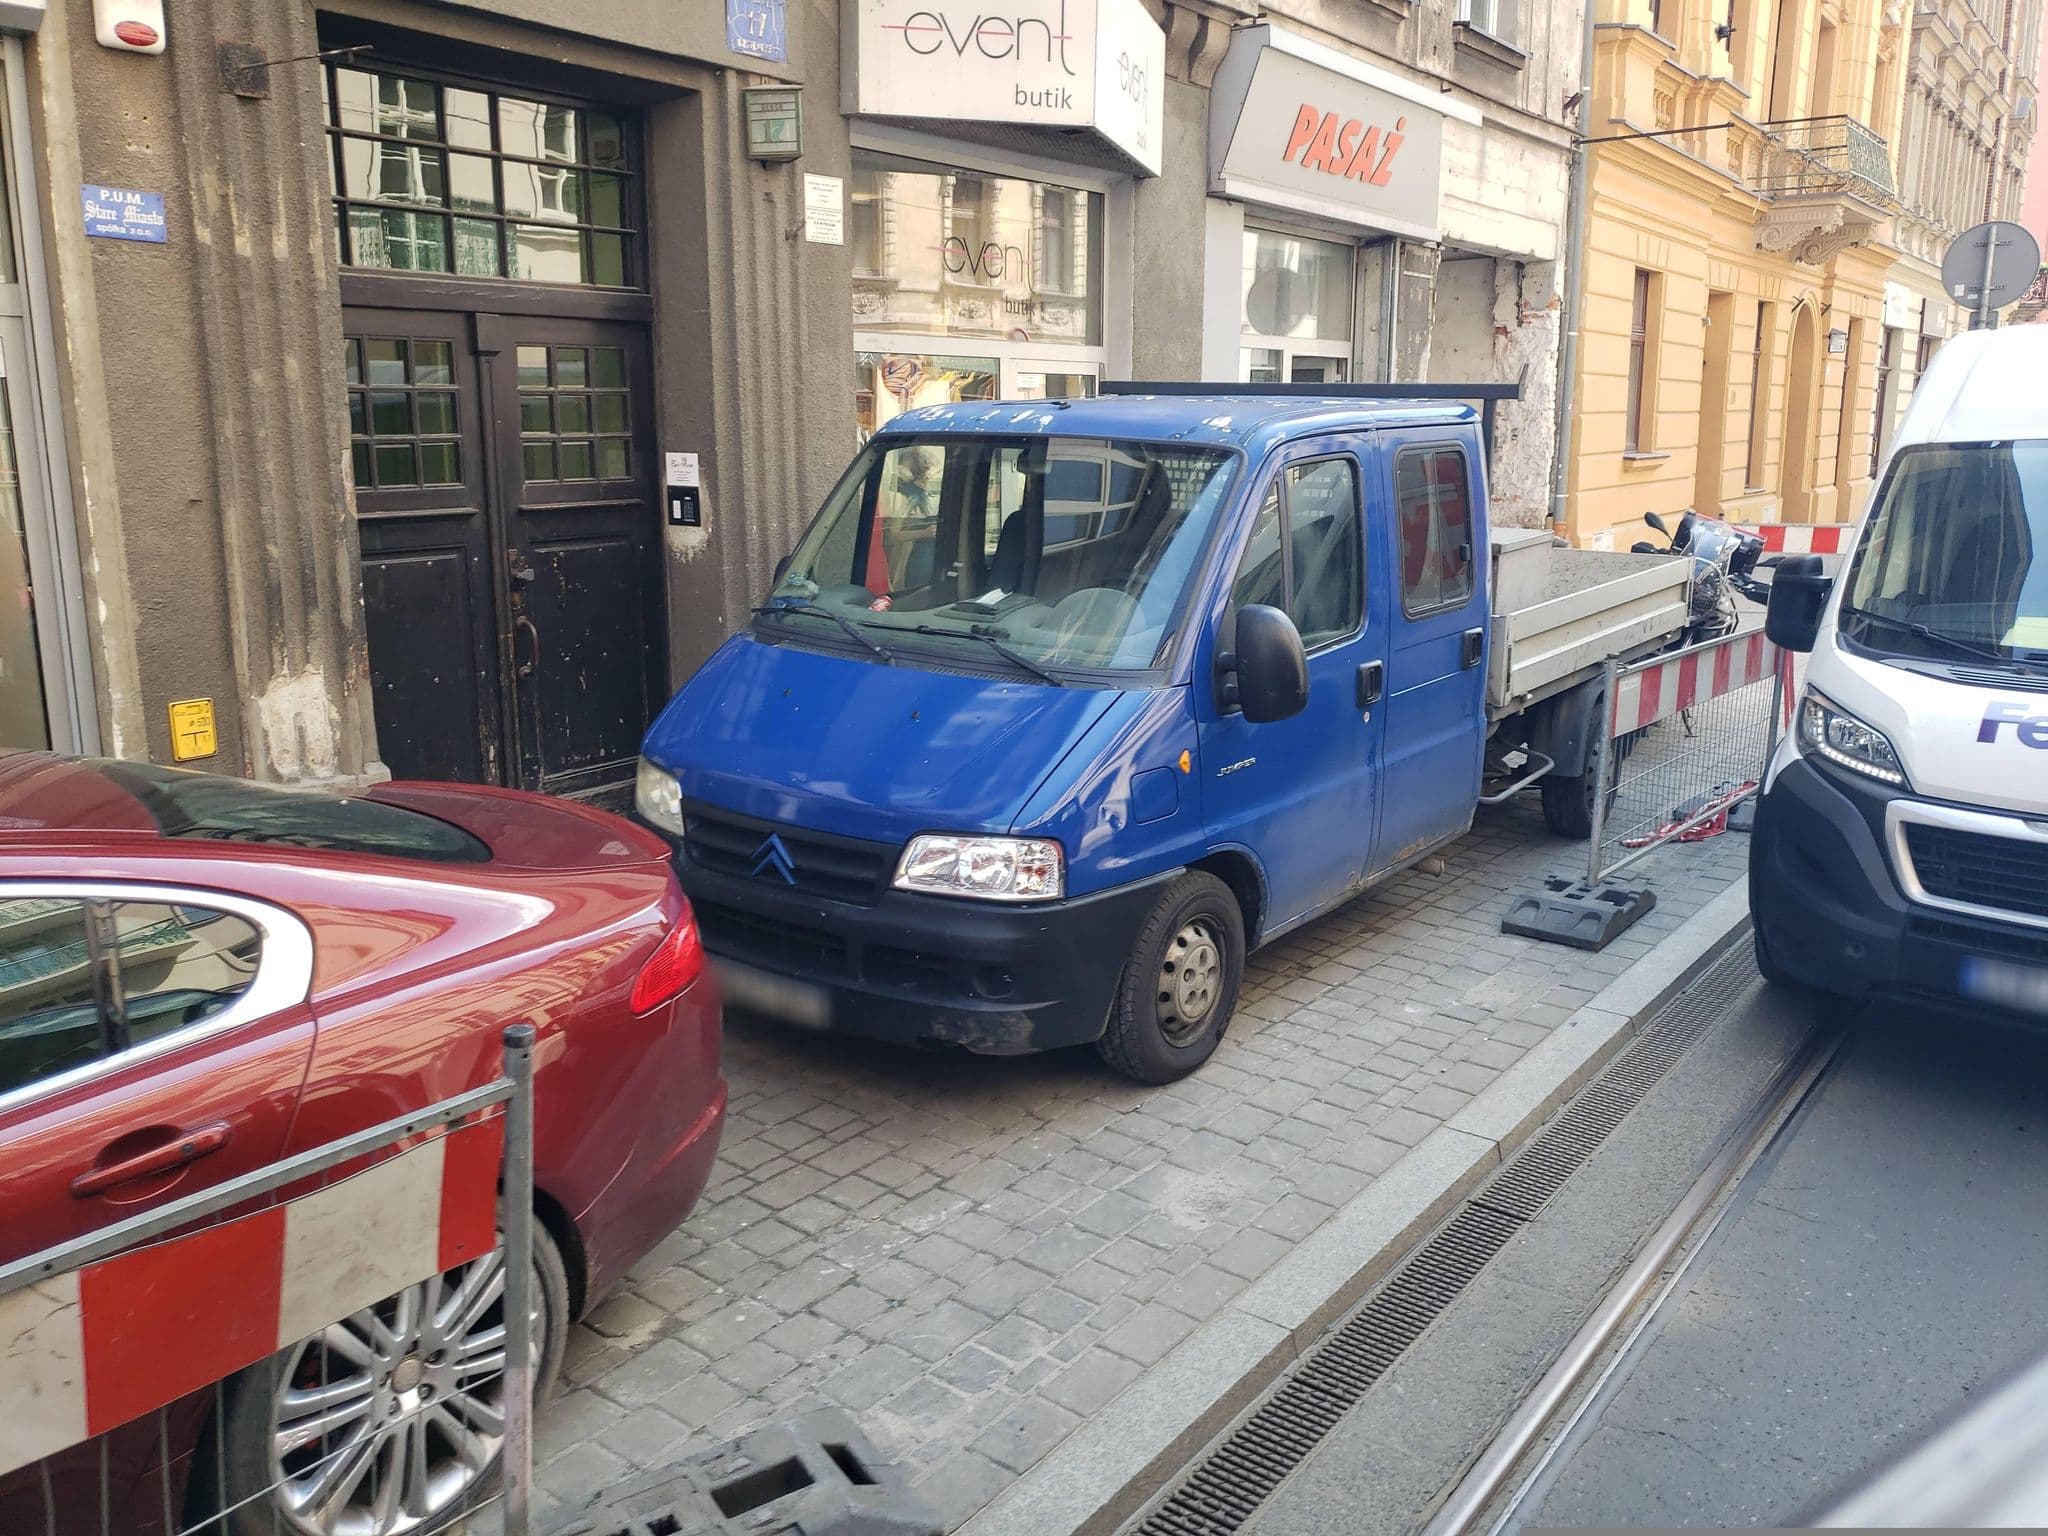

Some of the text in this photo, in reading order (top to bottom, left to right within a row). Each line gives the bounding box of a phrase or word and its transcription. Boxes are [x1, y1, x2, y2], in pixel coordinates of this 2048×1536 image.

[748, 9, 768, 37] 17
[881, 0, 1075, 76] event
[1014, 84, 1074, 110] butik
[763, 119, 785, 143] 17
[1282, 103, 1407, 186] PASAŻ
[100, 189, 145, 205] P.U.M.
[84, 200, 163, 227] Stare Miasto
[928, 228, 1037, 295] event
[1005, 297, 1036, 317] butik
[1216, 757, 1256, 777] JUMPER
